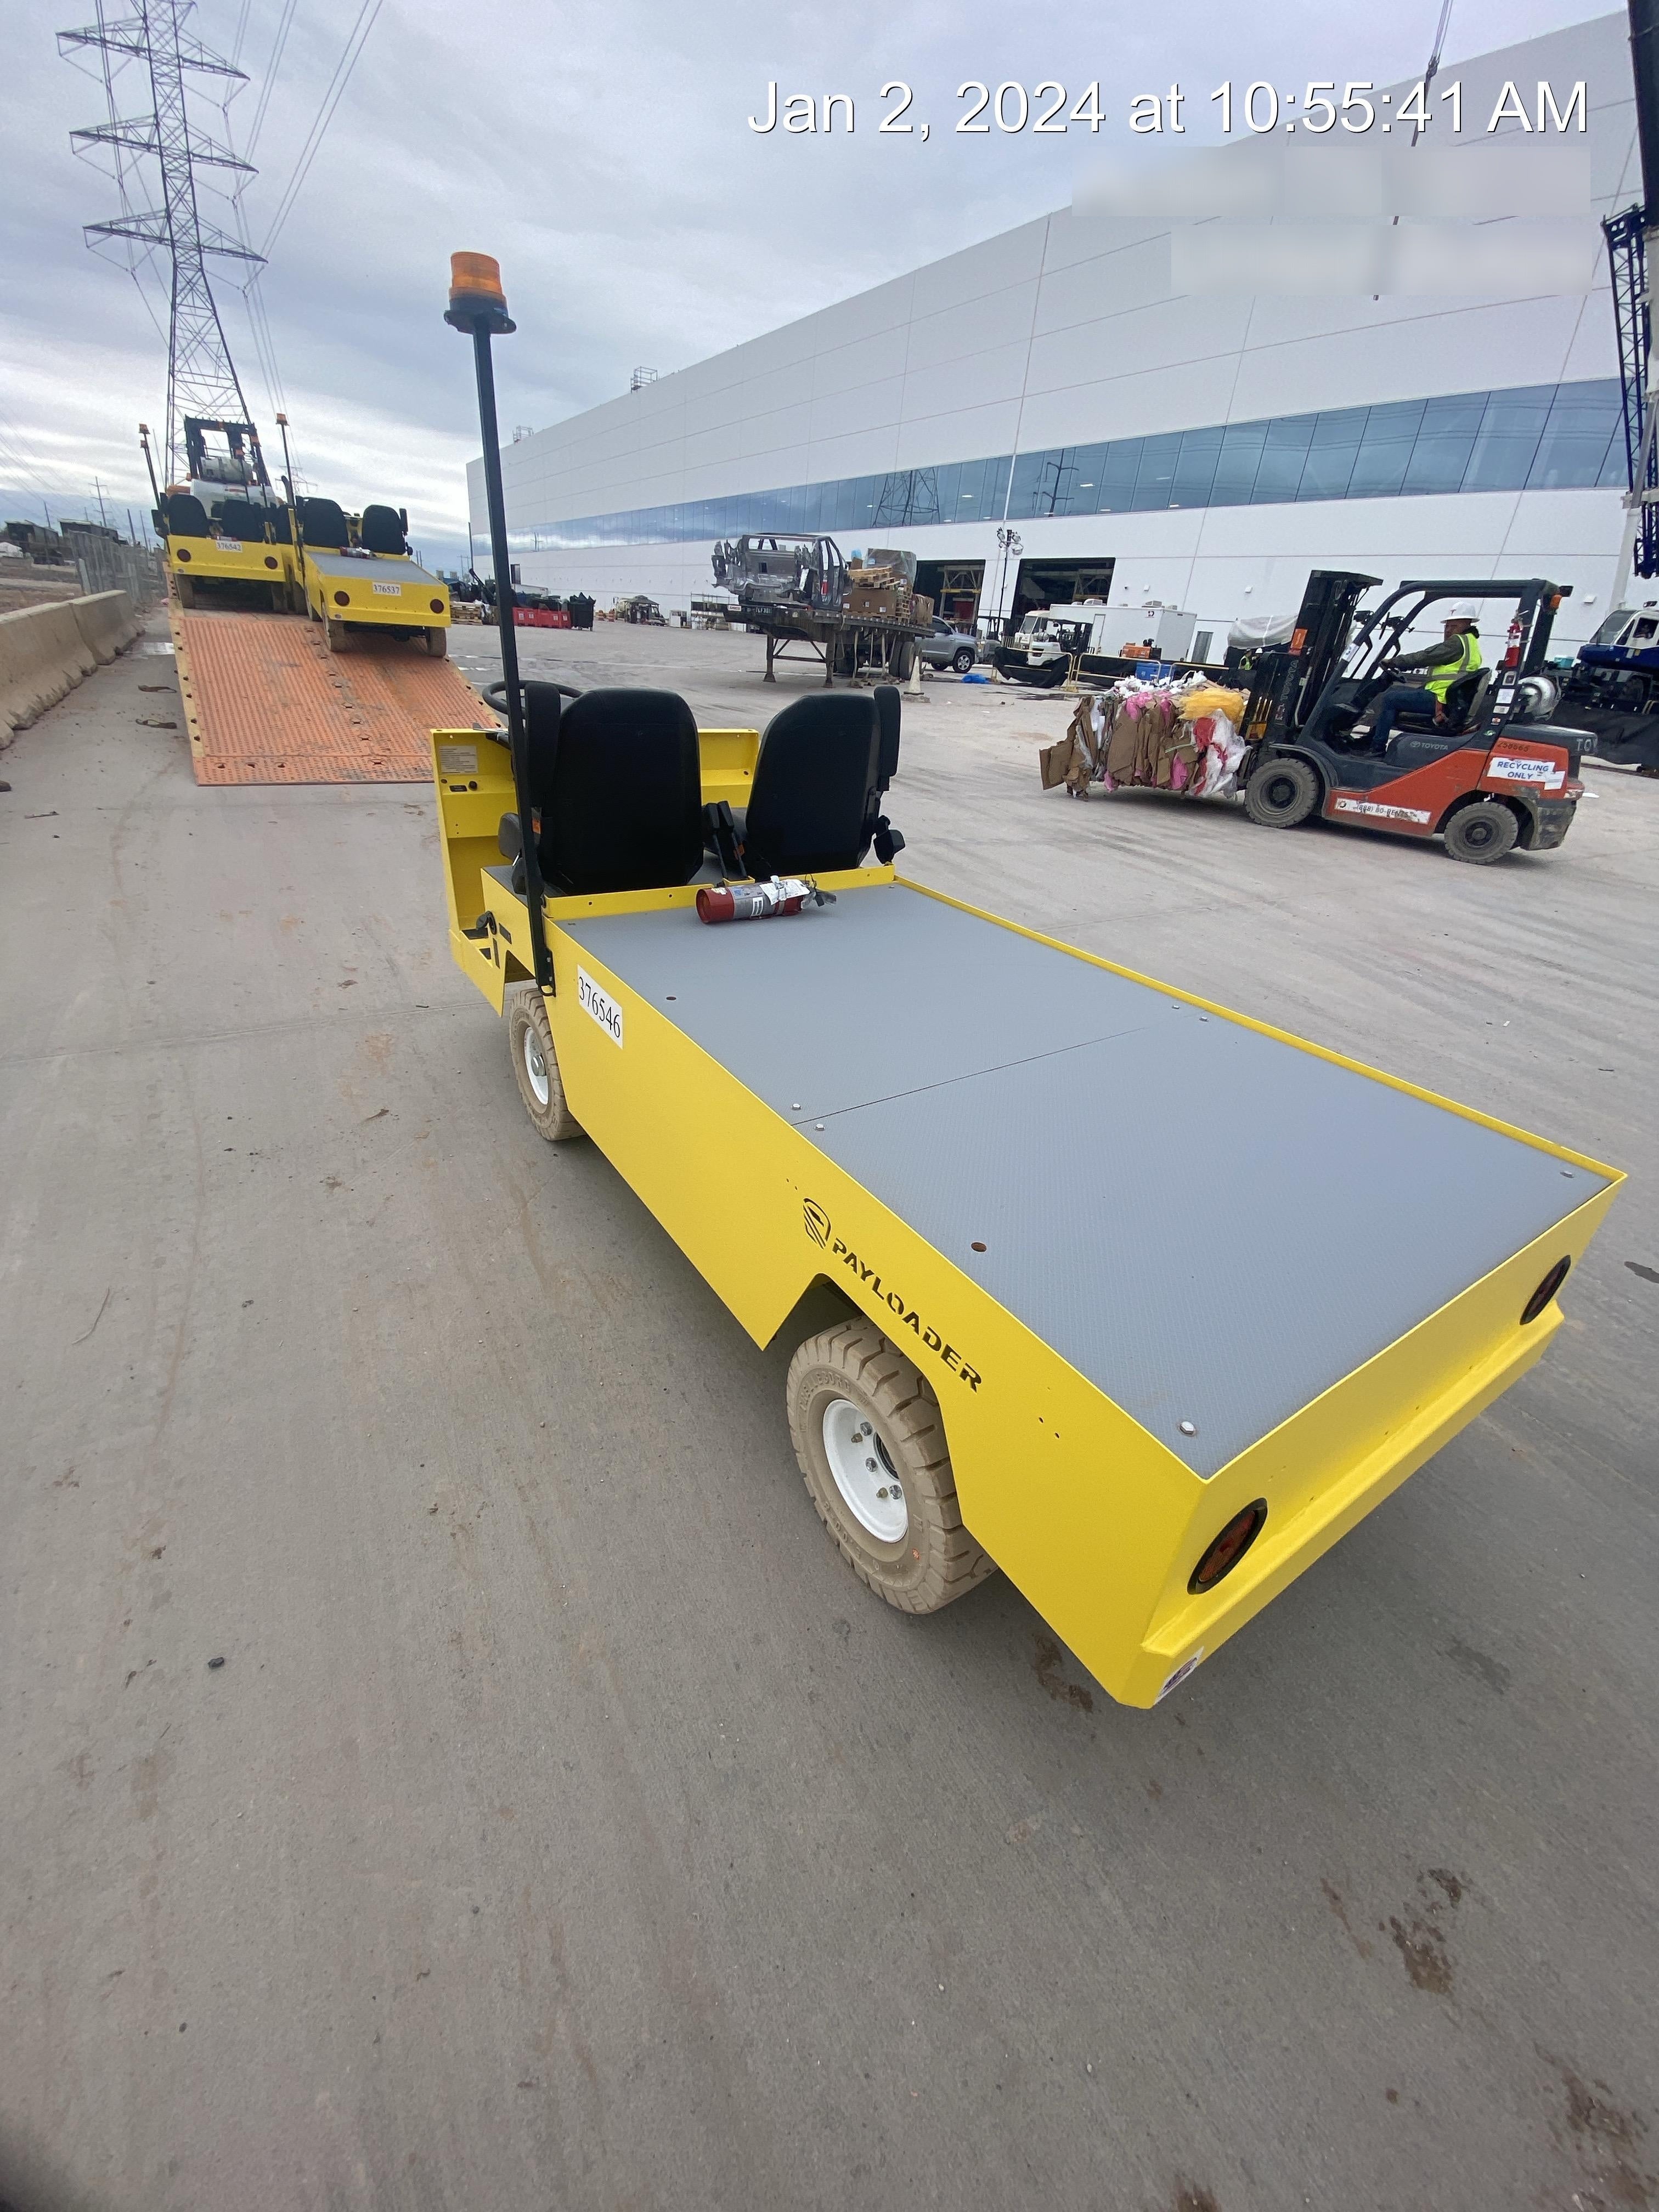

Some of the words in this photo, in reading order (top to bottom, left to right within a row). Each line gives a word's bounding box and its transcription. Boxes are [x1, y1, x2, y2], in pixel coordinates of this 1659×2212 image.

[373, 584, 400, 594] 376537
[1497, 761, 1549, 771] RECYCLING
[579, 977, 620, 1037] 376546
[832, 1237, 982, 1393] PAYLOADER
